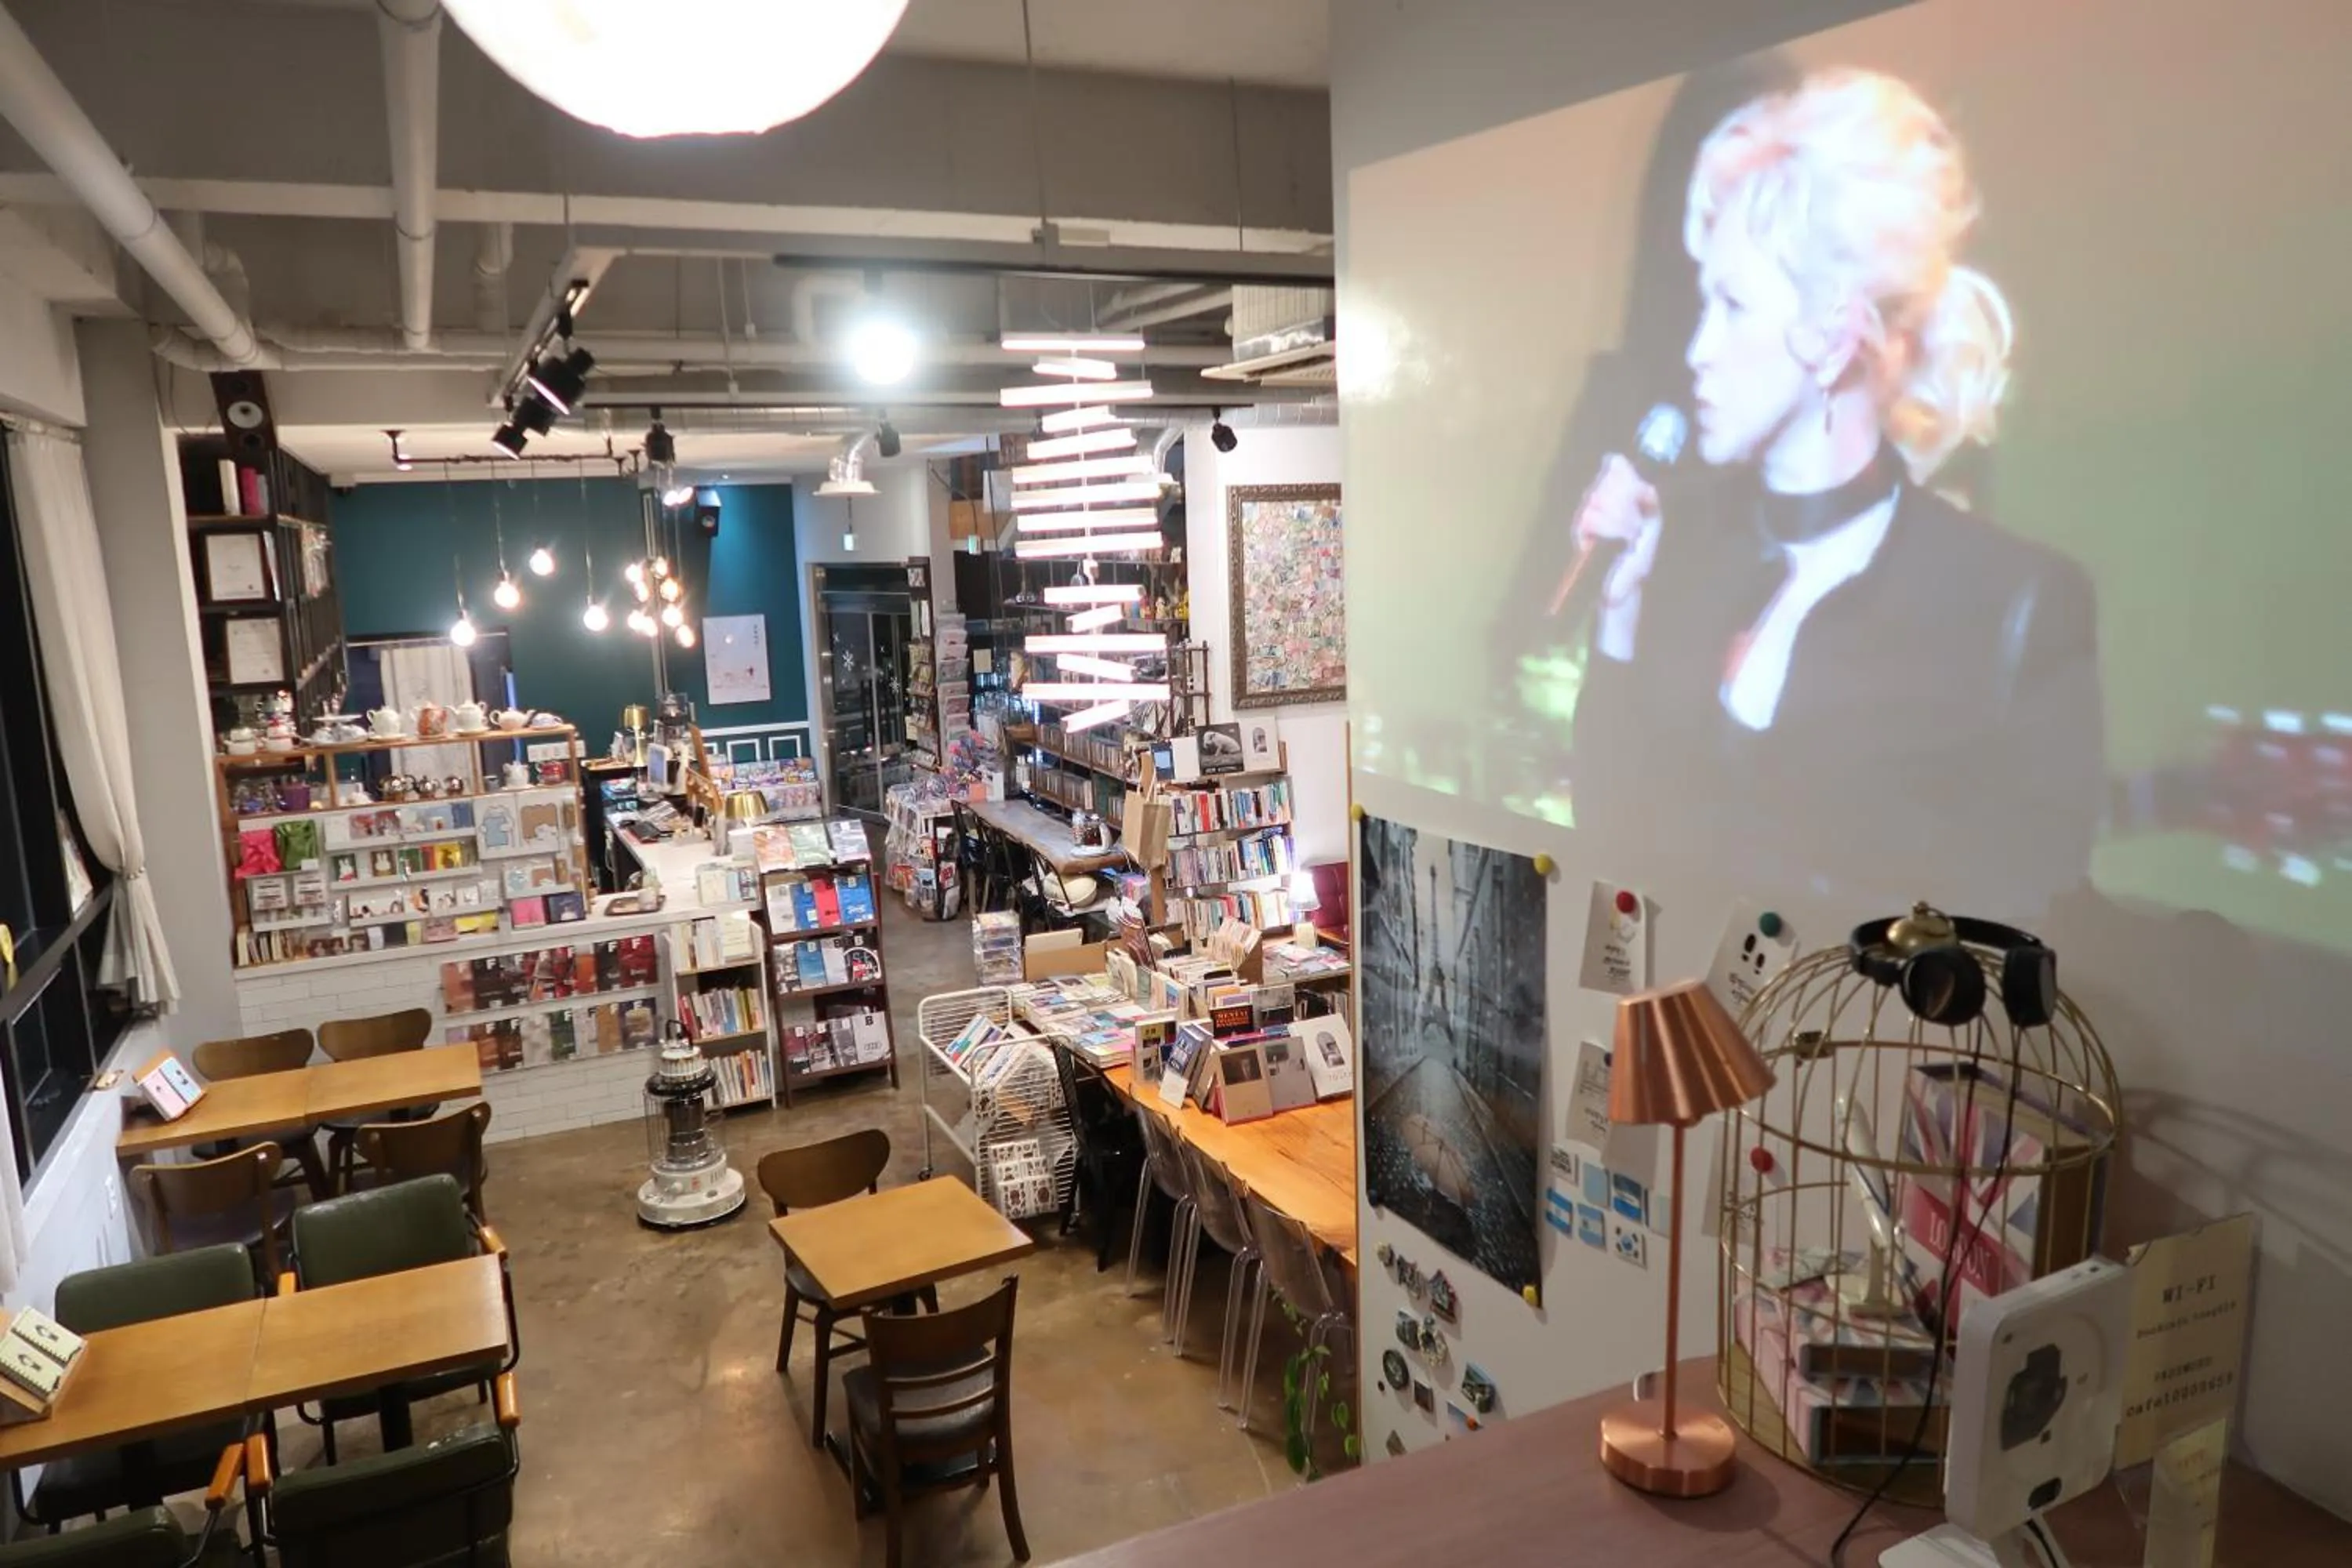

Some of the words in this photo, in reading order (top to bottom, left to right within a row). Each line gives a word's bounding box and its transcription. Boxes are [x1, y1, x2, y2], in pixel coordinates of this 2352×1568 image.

[608, 942, 618, 953] F
[632, 938, 641, 949] F
[486, 958, 496, 970] F
[2162, 1274, 2216, 1304] WI-FI
